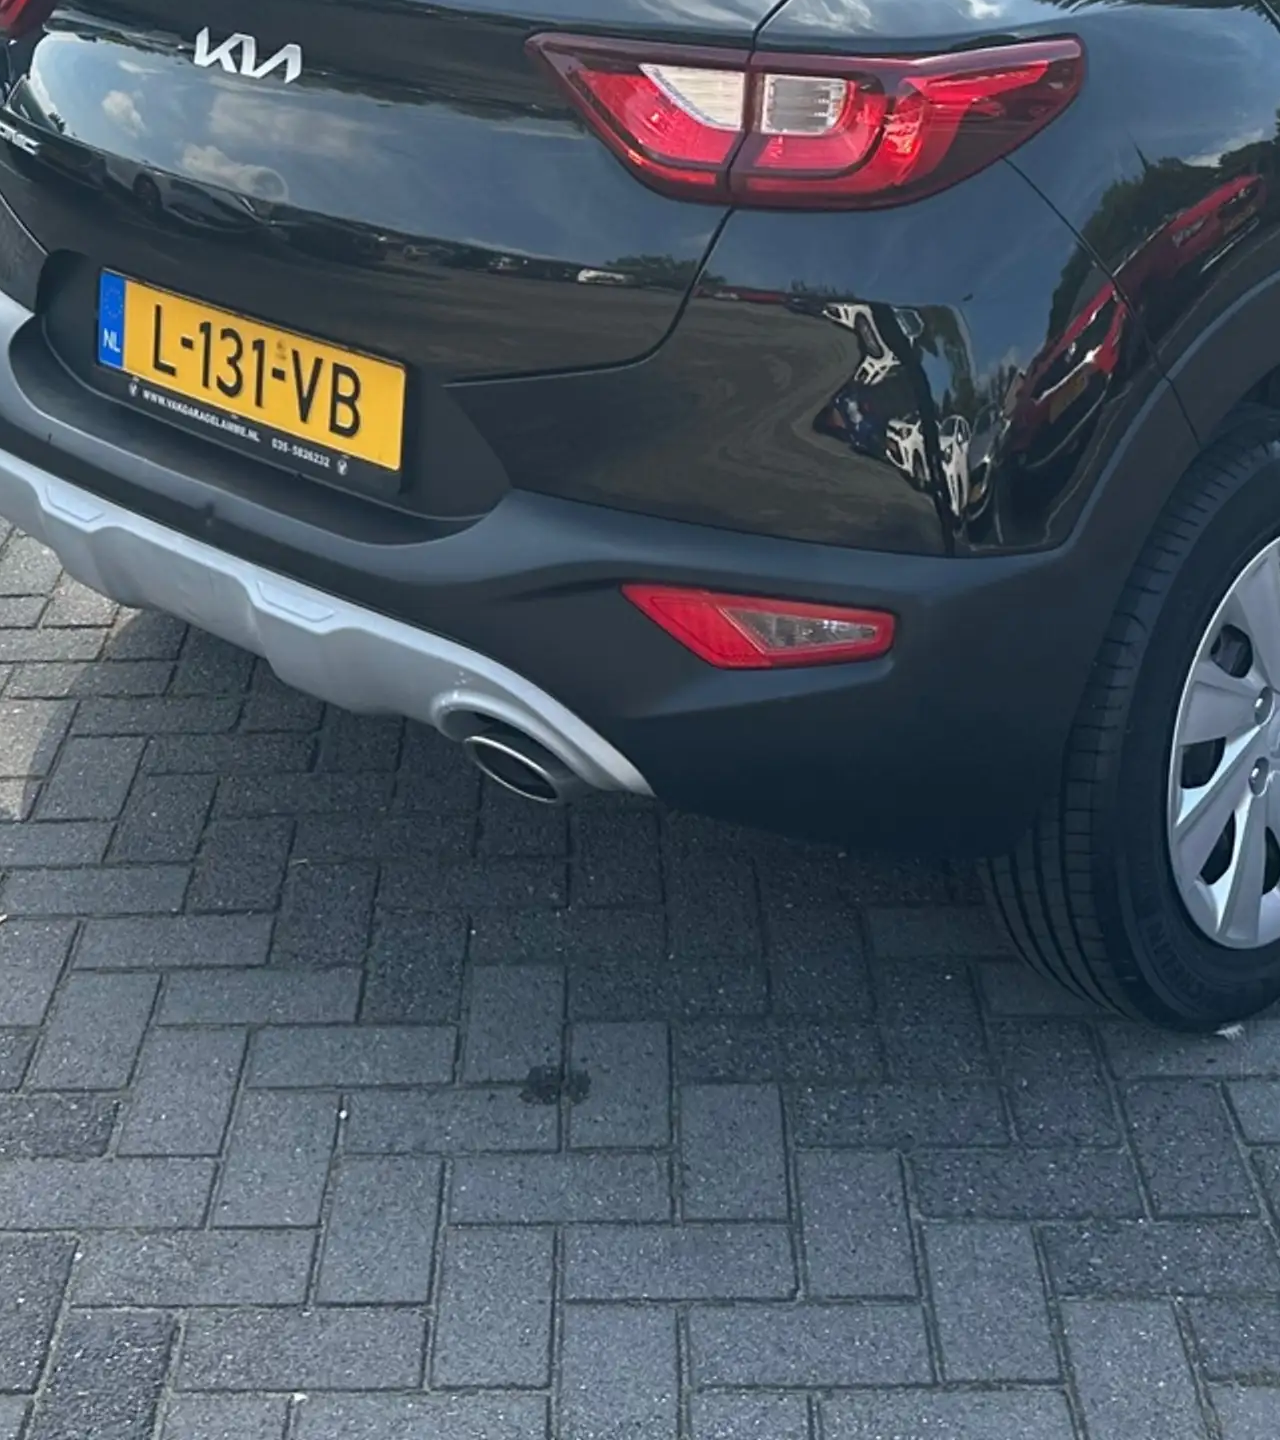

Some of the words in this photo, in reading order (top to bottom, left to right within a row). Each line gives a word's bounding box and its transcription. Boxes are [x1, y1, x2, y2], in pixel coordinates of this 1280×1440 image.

[193, 25, 302, 85] KIA
[102, 328, 121, 353] NL
[152, 303, 362, 438] L-131-VB
[142, 388, 261, 442] WWW.VAKGARAGELAMME.NL
